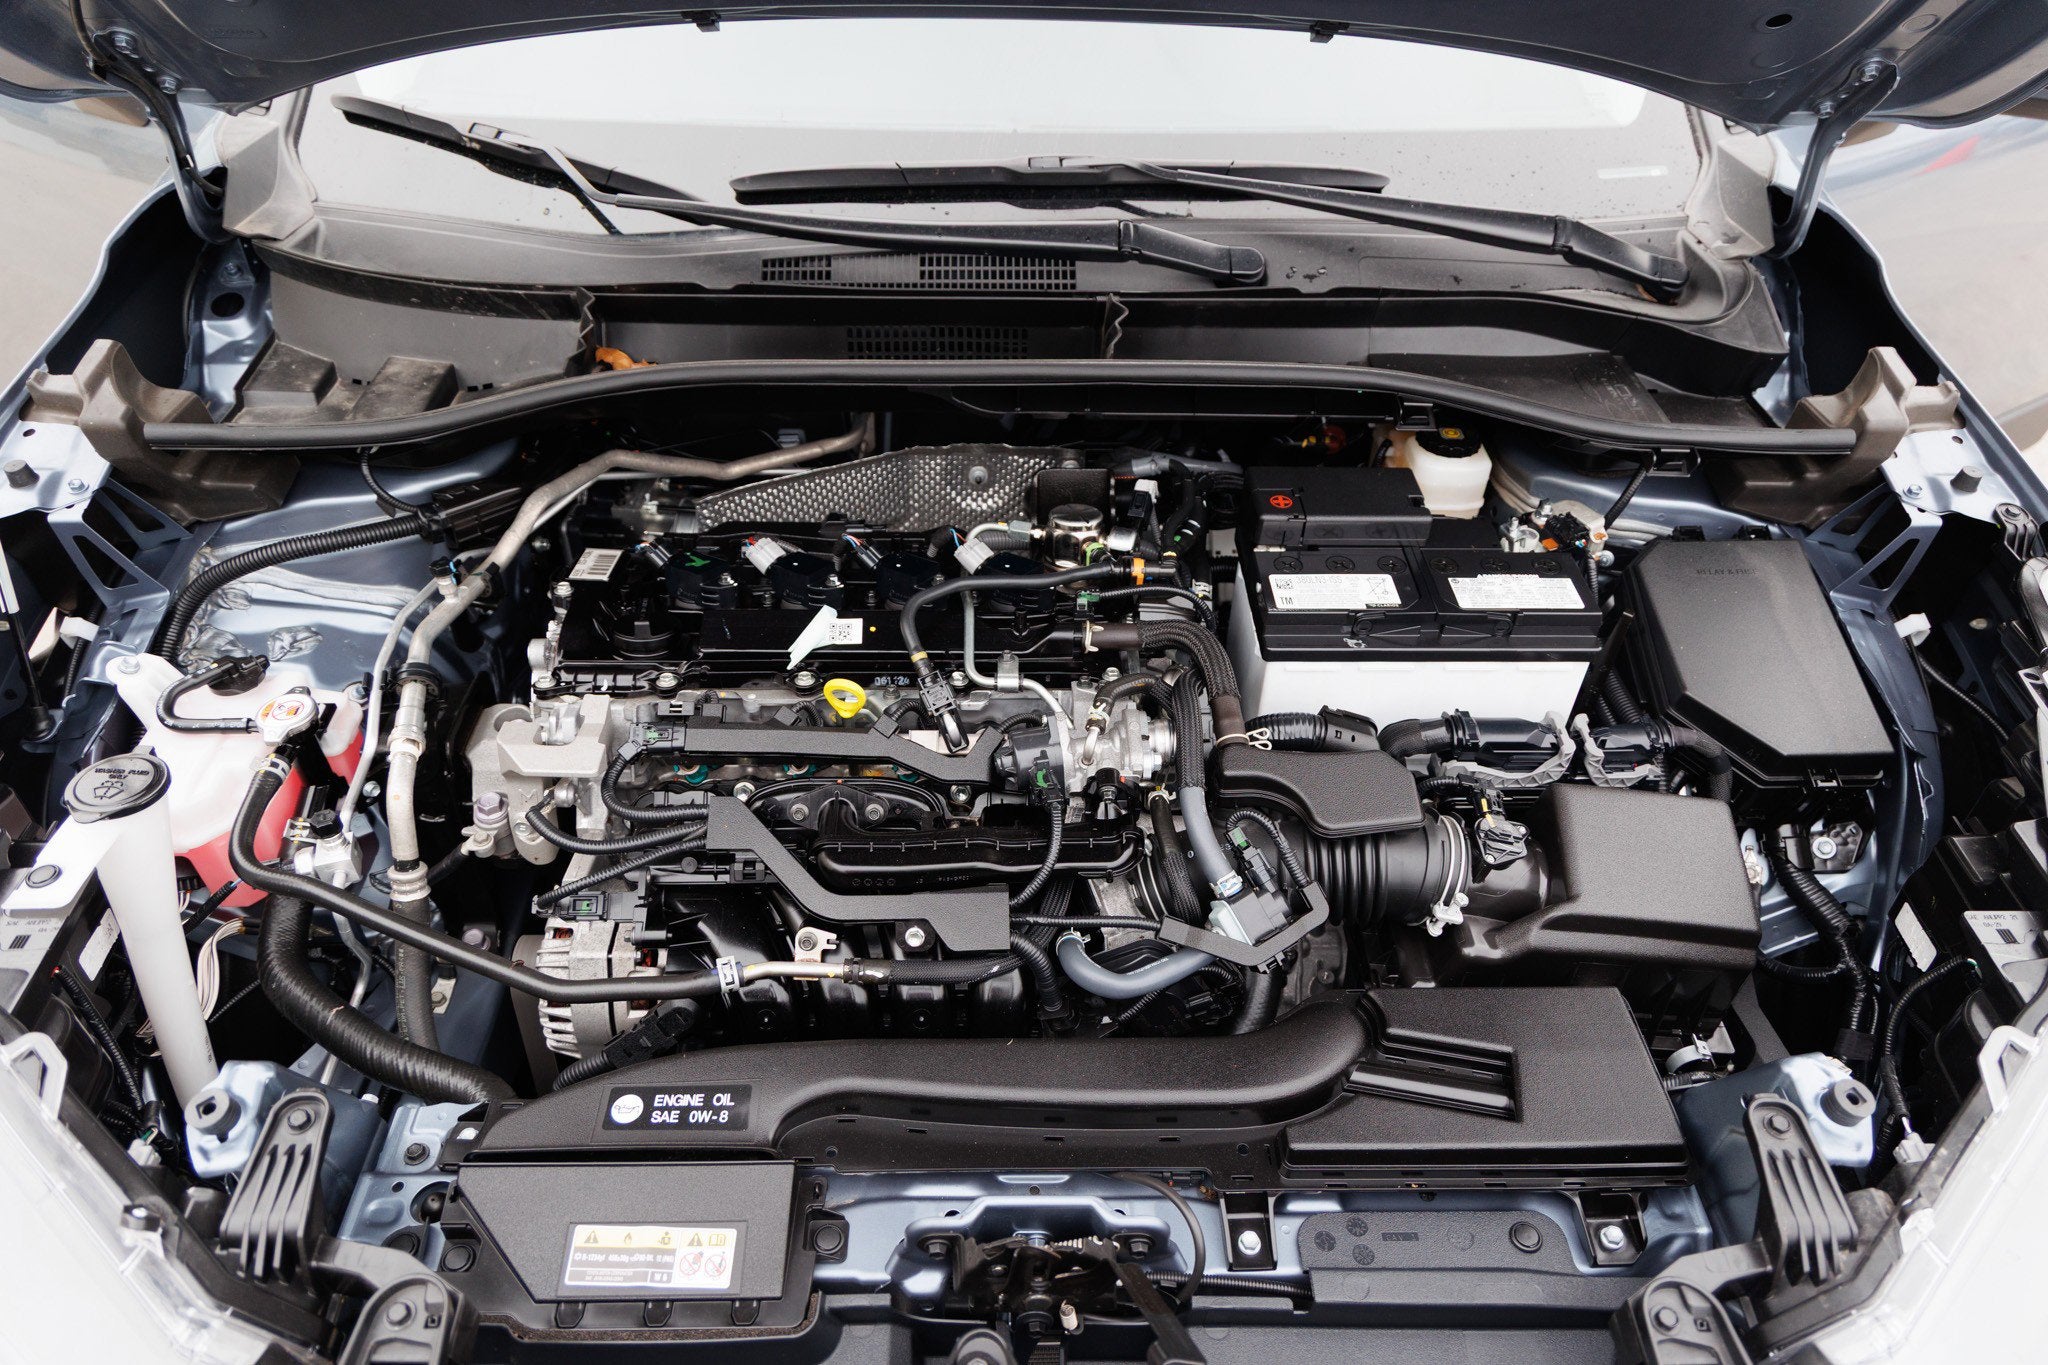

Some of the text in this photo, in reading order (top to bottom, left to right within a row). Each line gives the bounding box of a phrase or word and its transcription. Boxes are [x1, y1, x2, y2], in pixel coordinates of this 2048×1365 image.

[1280, 596, 1294, 605] TM
[653, 1093, 735, 1107] ENGINE OIL
[650, 1110, 729, 1123] SAE 0W-8
